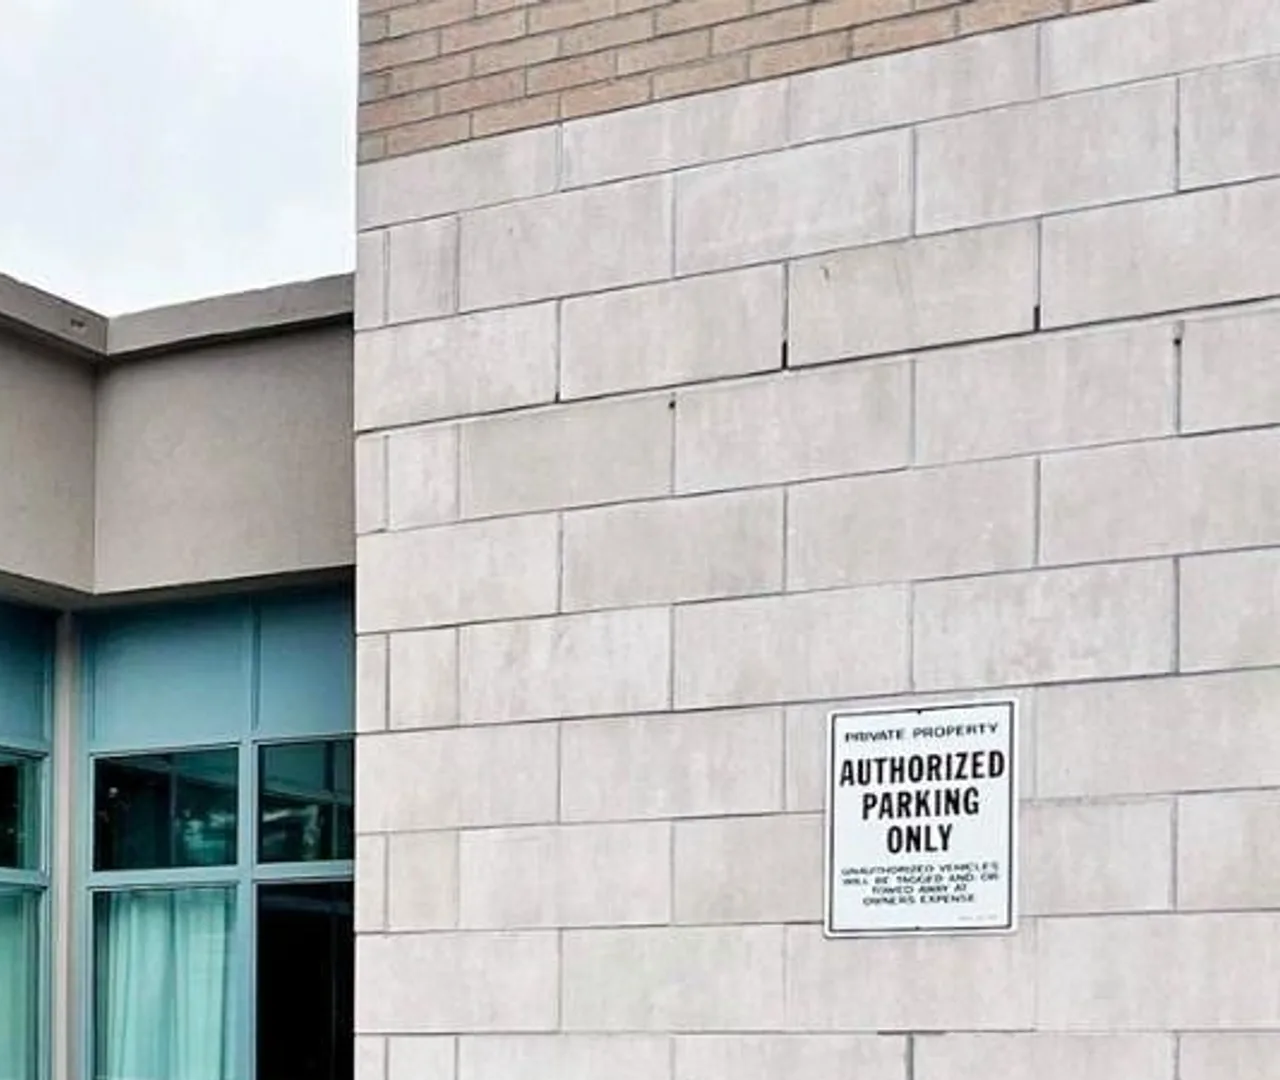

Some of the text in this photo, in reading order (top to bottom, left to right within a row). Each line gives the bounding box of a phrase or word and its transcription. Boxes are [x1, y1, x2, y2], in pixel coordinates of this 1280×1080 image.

[845, 722, 999, 743] PRIVATE PROPERTY
[839, 750, 1005, 787] AUTHORIZED
[862, 787, 979, 821] PARKING
[886, 823, 953, 854] ONLY
